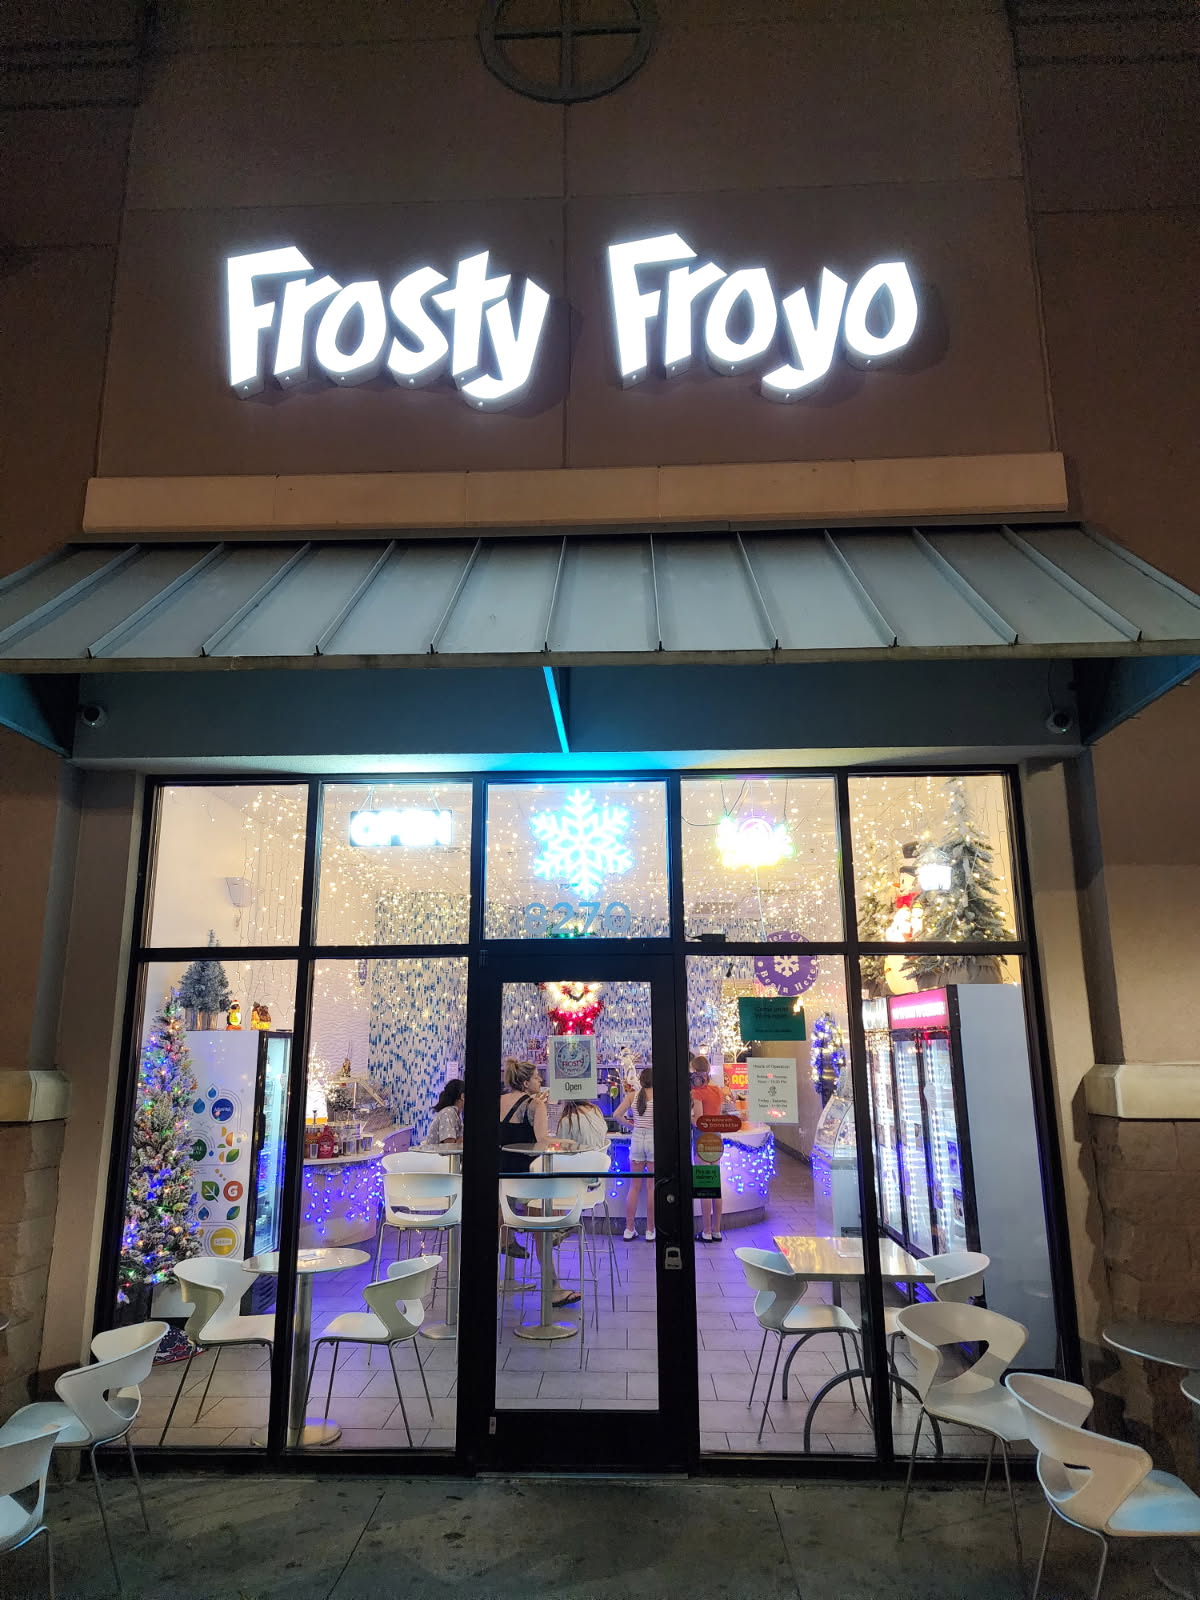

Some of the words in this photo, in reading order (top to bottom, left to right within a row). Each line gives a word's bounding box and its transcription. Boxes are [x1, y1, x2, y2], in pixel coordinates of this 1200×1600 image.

[225, 244, 550, 406] Frosty
[606, 231, 920, 395] Froyo
[524, 901, 631, 935] 8270
[760, 970, 789, 994] Begin
[794, 968, 816, 992] Here
[564, 1081, 582, 1093] Open
